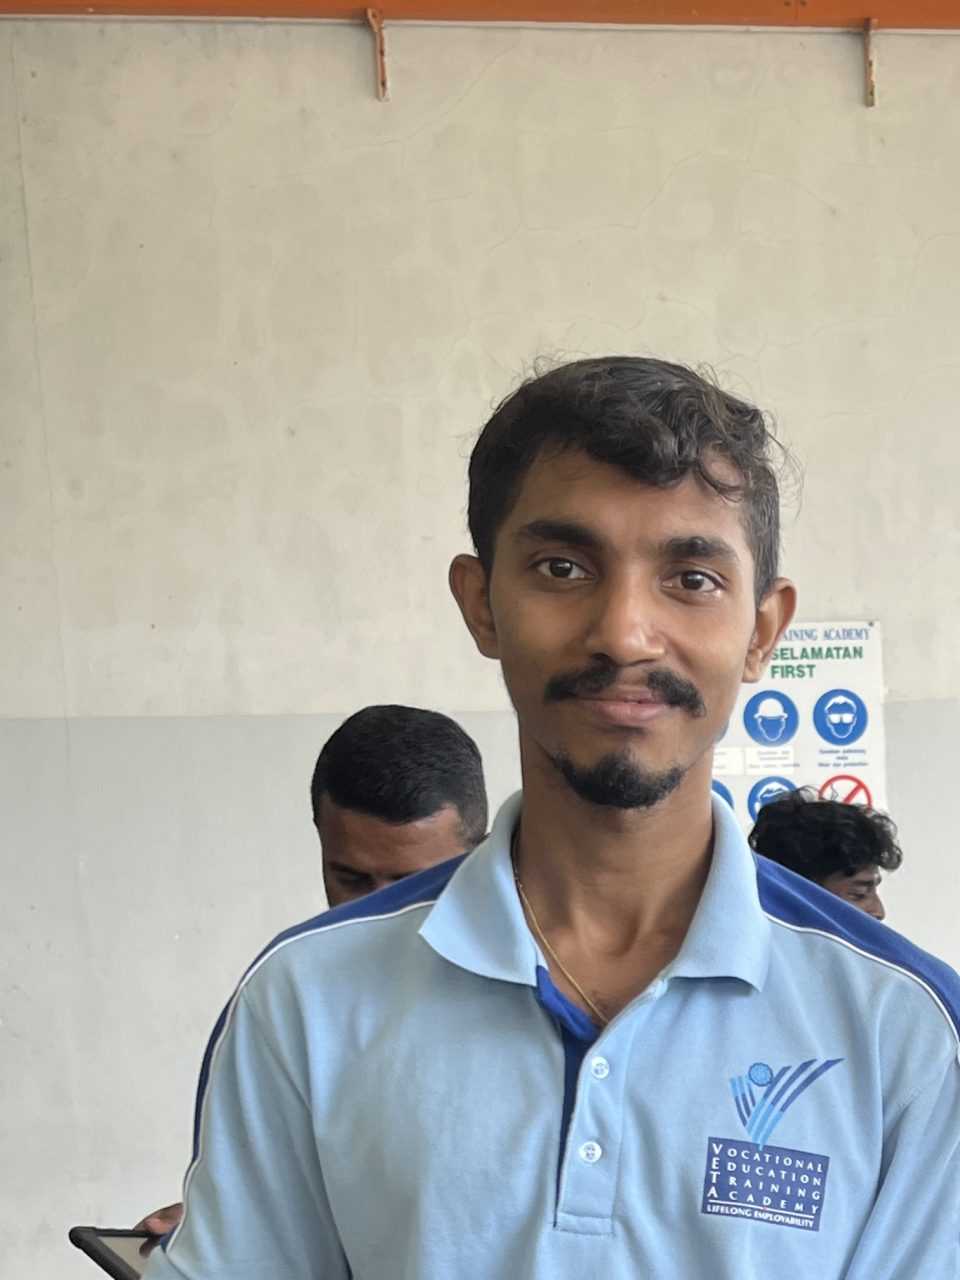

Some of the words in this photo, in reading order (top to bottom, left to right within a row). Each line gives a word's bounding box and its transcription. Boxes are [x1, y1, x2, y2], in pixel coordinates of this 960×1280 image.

[783, 629, 818, 641] AINING
[823, 628, 869, 640] ACADEMY
[771, 646, 863, 660] SELAMATAN
[771, 664, 816, 679] FIRST
[712, 1143, 823, 1173] VOCATIONAL
[711, 1157, 821, 1186] EDUCATION
[710, 1171, 820, 1200] TRAINING
[707, 1186, 819, 1214] ACADEMY
[707, 1205, 752, 1217] LIFELONG
[754, 1211, 815, 1228] EMPLOYABILITY
